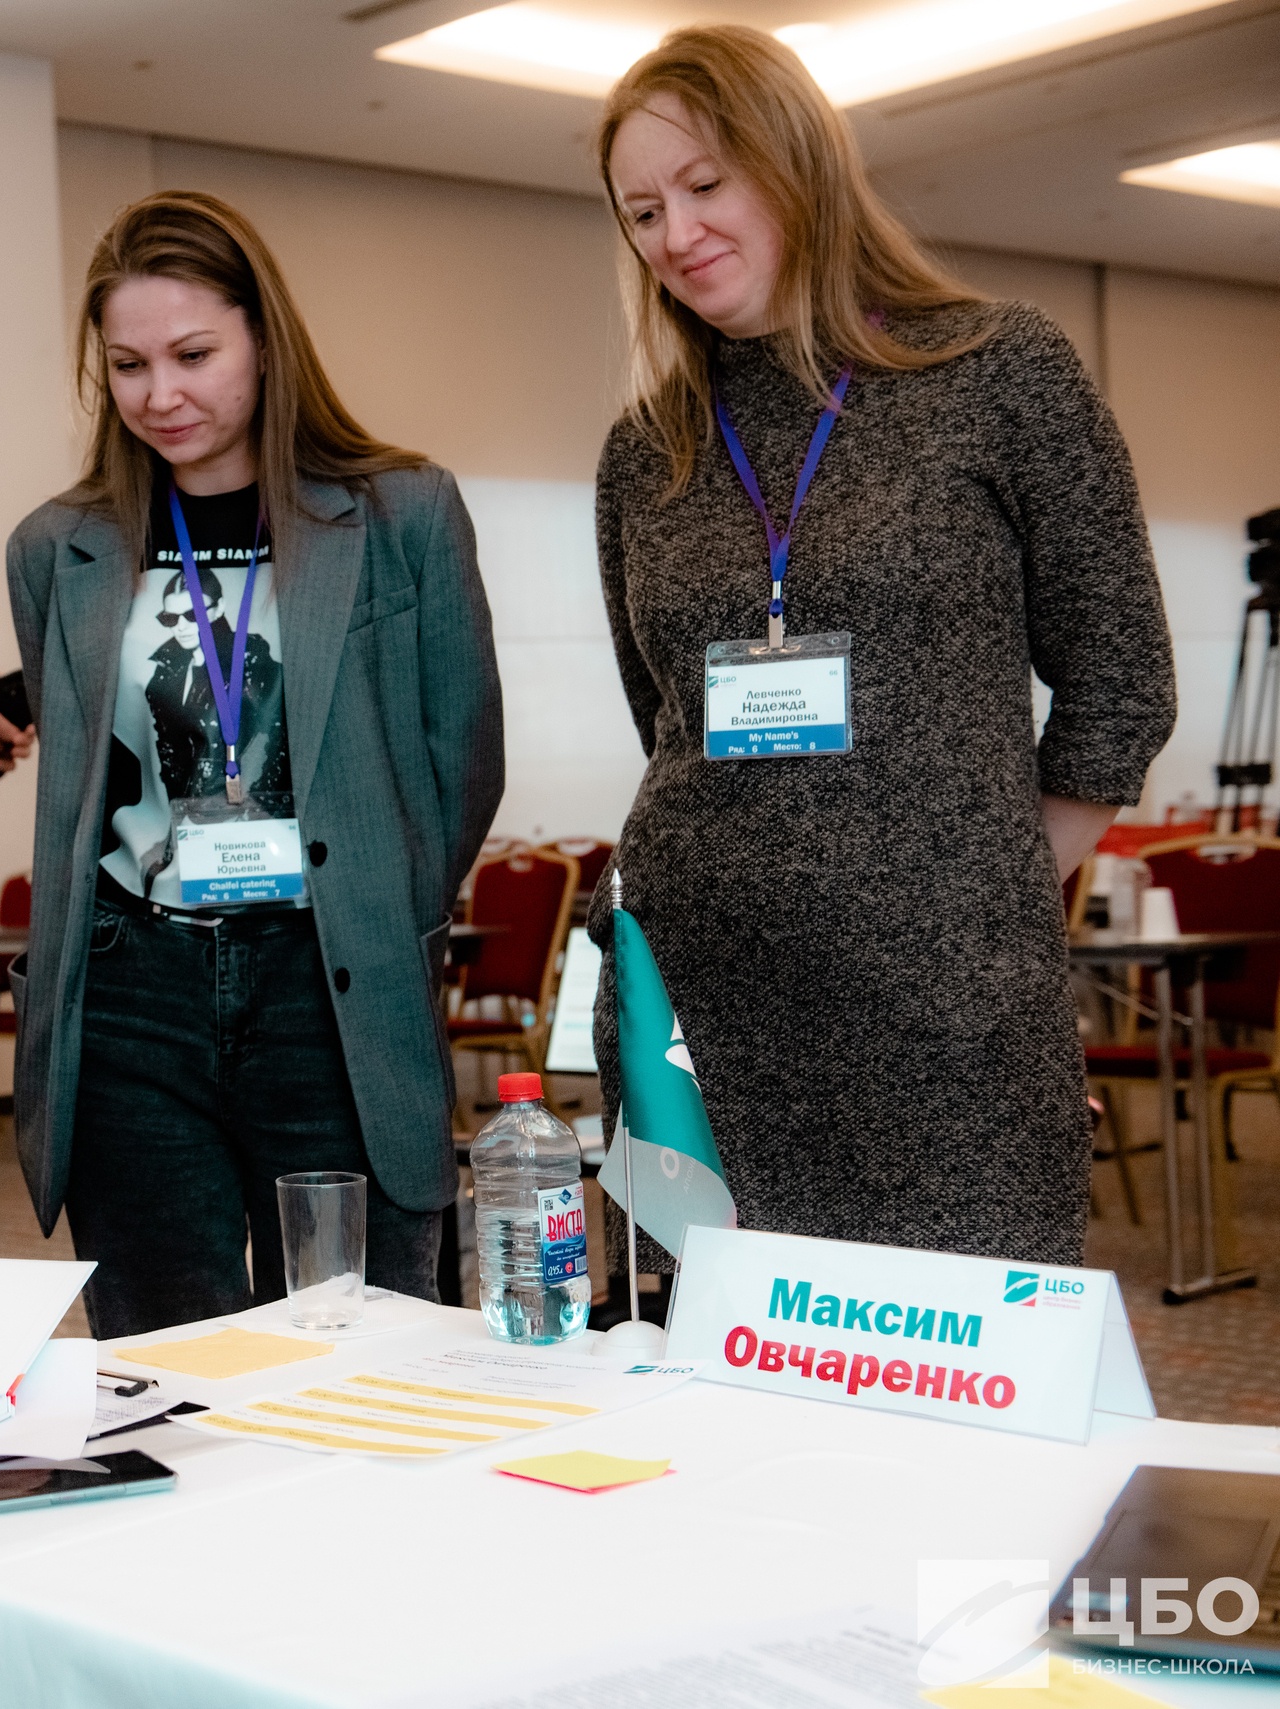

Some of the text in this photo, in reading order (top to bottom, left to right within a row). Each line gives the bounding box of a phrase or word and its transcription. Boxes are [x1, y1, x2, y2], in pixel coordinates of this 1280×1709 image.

[157, 549, 212, 562] SIAM
[746, 688, 802, 700] Левченко
[742, 700, 807, 714] Надежда
[731, 713, 818, 726] Владимировна
[749, 731, 799, 743] My Name's
[751, 745, 759, 754] 6
[773, 742, 802, 752] Место:
[809, 742, 816, 750] 8
[214, 841, 266, 852] Новикова
[221, 852, 261, 864] Елена
[217, 864, 266, 876] Юрьевна
[241, 879, 276, 890] catering
[546, 1208, 583, 1242] ВИСТА
[1045, 1279, 1085, 1295] ЦБО
[767, 1277, 983, 1347] Максим
[724, 1325, 1017, 1409] Овчаренко
